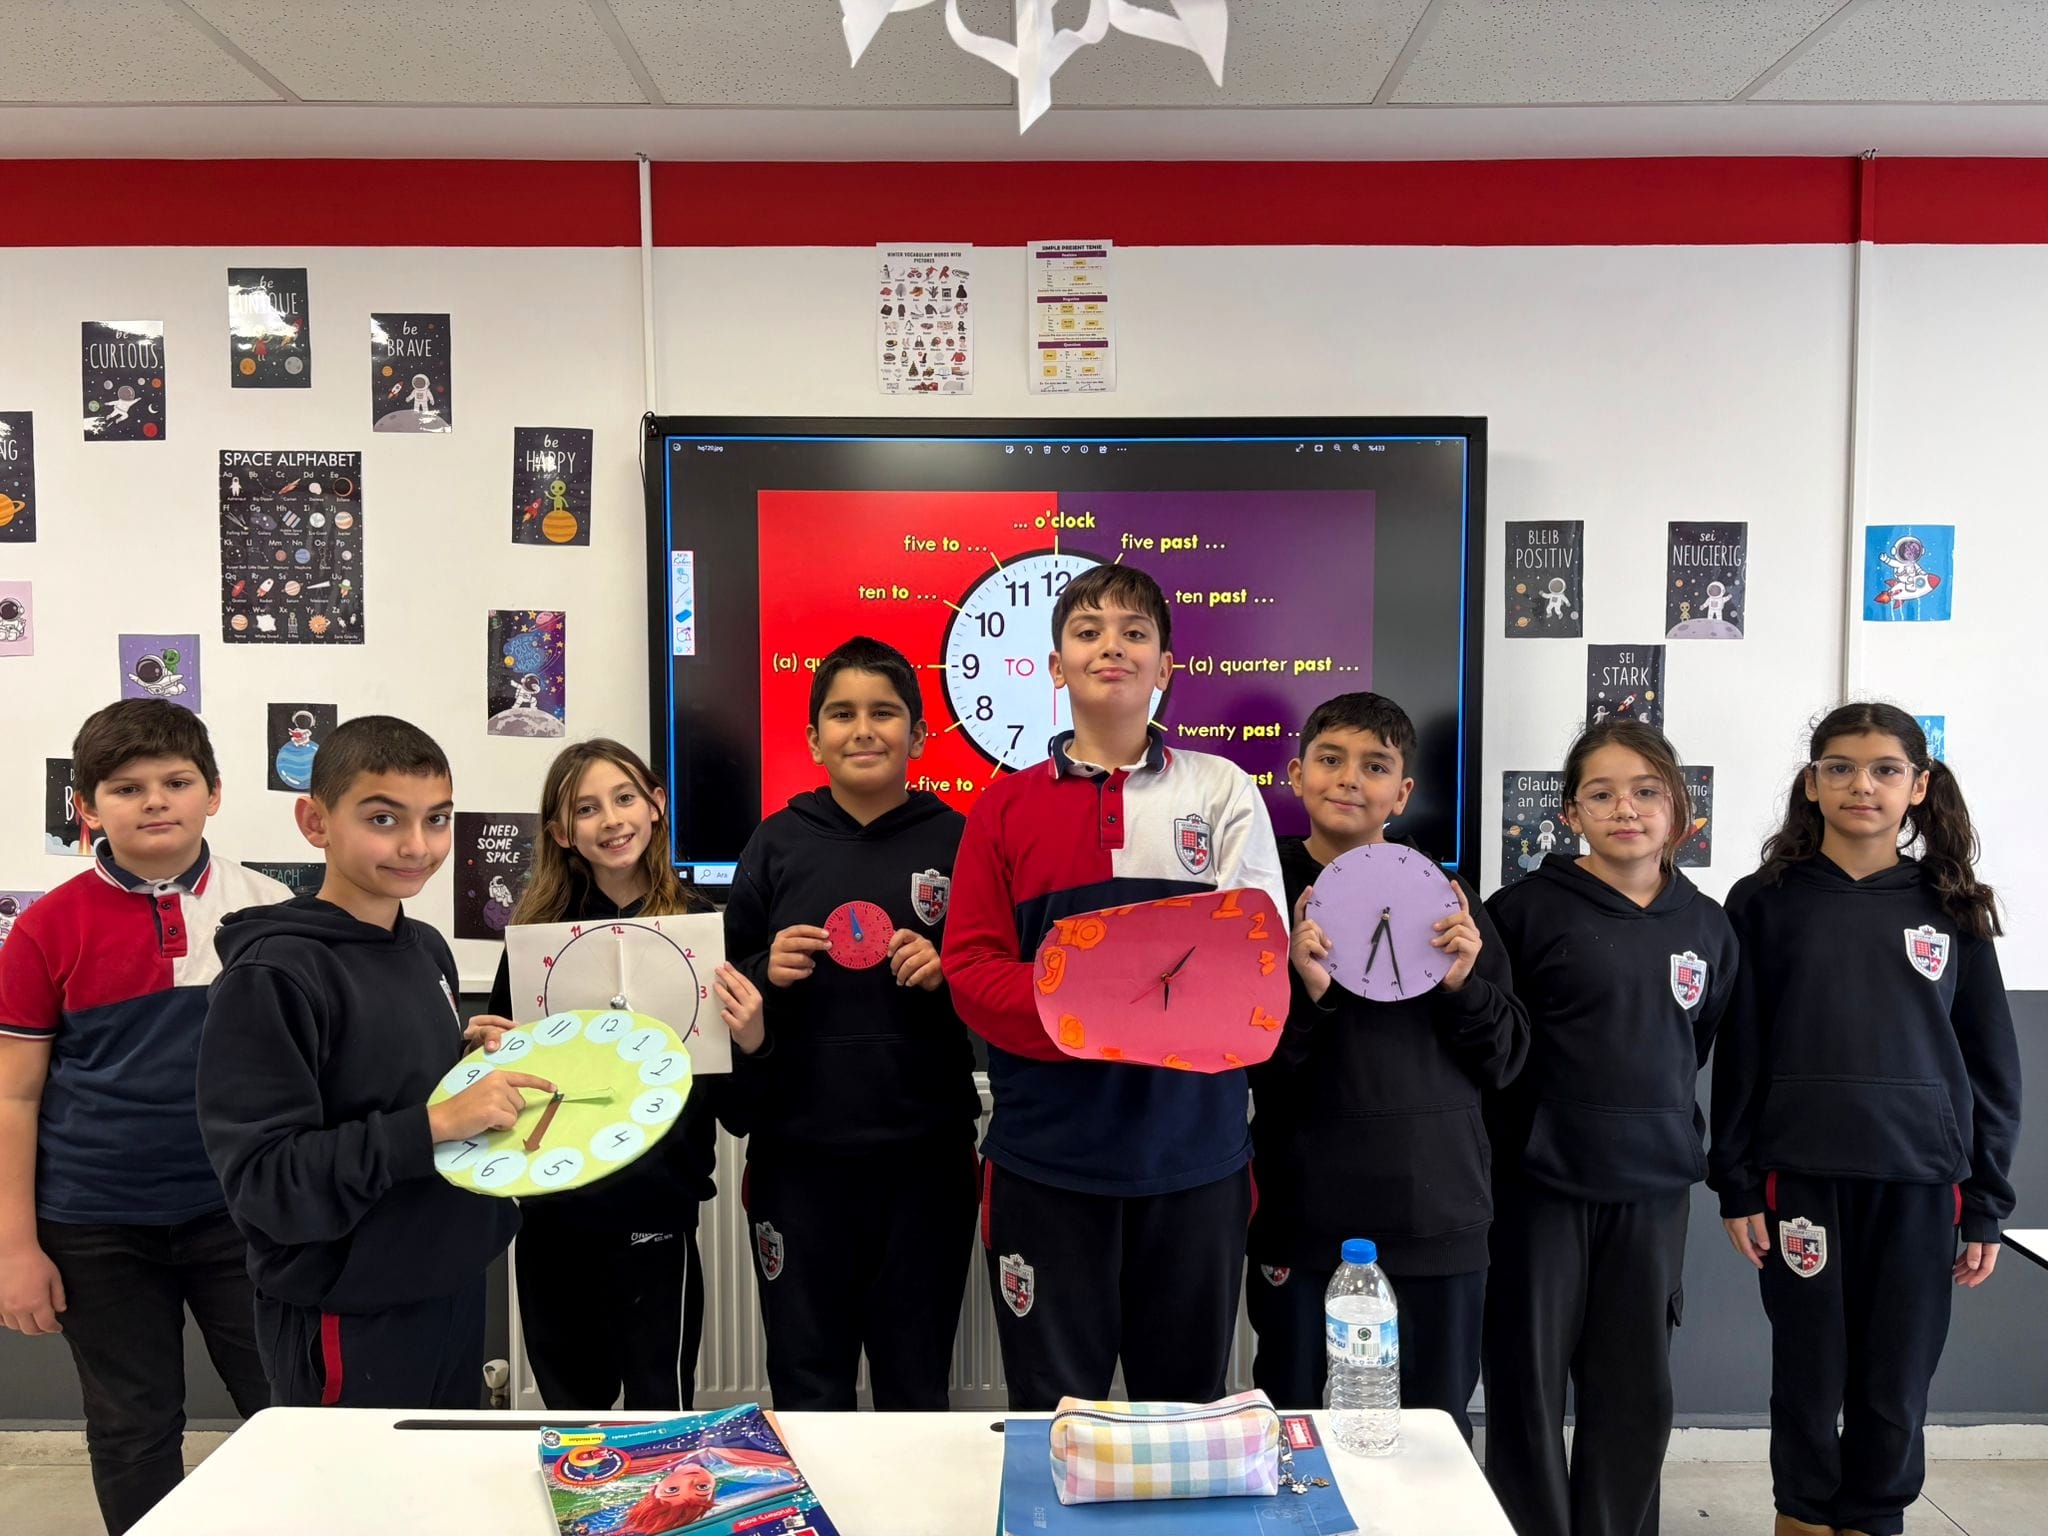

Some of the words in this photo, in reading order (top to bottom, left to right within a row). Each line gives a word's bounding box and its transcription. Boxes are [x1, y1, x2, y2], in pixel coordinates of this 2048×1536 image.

[260, 275, 274, 288] be
[402, 321, 418, 335] be
[90, 343, 158, 369] CURIOUS
[387, 339, 432, 357] BRAVE
[544, 434, 559, 448] be
[224, 453, 272, 466] SPACE
[277, 453, 356, 467] ALPHABET
[526, 450, 576, 474] HAPPY
[1034, 510, 1096, 529] o'clock
[903, 535, 937, 551] five
[942, 537, 960, 551] to
[1121, 533, 1154, 549] five
[1161, 535, 1199, 553] past
[1528, 529, 1560, 545] BLEIB
[1699, 530, 1716, 542] sei
[1515, 548, 1573, 569] POSITIV
[1672, 545, 1742, 567] NEUGIERIG
[858, 585, 886, 600] ten
[891, 584, 909, 600] to
[1040, 571, 1072, 597] 12
[1005, 581, 1030, 607] 11
[1175, 589, 1203, 603] ten
[1209, 589, 1247, 607] past
[975, 611, 1005, 637] 10
[773, 652, 798, 673] (a)
[962, 653, 980, 679] 9
[1189, 656, 1214, 676] (a)
[1220, 658, 1288, 676] quarter
[1294, 657, 1332, 675] past
[1619, 652, 1635, 664] SEI
[1004, 659, 1035, 677] TO
[1602, 666, 1649, 686] STARK
[975, 695, 993, 721] 8
[1007, 725, 1024, 750] 7
[1178, 723, 1236, 741] twenty
[1243, 723, 1281, 741] past
[956, 778, 974, 792] to
[1517, 797, 1534, 808] an
[482, 824, 487, 836] I
[489, 825, 518, 836] NEED
[477, 838, 512, 850] SOME
[486, 852, 520, 863] SPACE
[1398, 856, 1408, 864] 2
[571, 925, 582, 938] 11
[612, 926, 624, 934] 12
[1053, 916, 1107, 950] 10
[1248, 912, 1269, 940] 2
[686, 949, 695, 958] 2
[1037, 946, 1067, 995] 9
[700, 986, 707, 998] 3
[537, 996, 544, 1007] 9
[547, 1020, 572, 1038] 11
[600, 1018, 619, 1032] 12
[501, 1037, 525, 1051] 10
[633, 1034, 650, 1052] 1
[650, 1058, 673, 1077] 2
[466, 1069, 480, 1085] 9
[646, 1098, 664, 1113] 3
[612, 1130, 630, 1148] 4
[451, 1140, 478, 1164] 7
[481, 1156, 510, 1177] 6
[544, 1159, 573, 1176] 5
